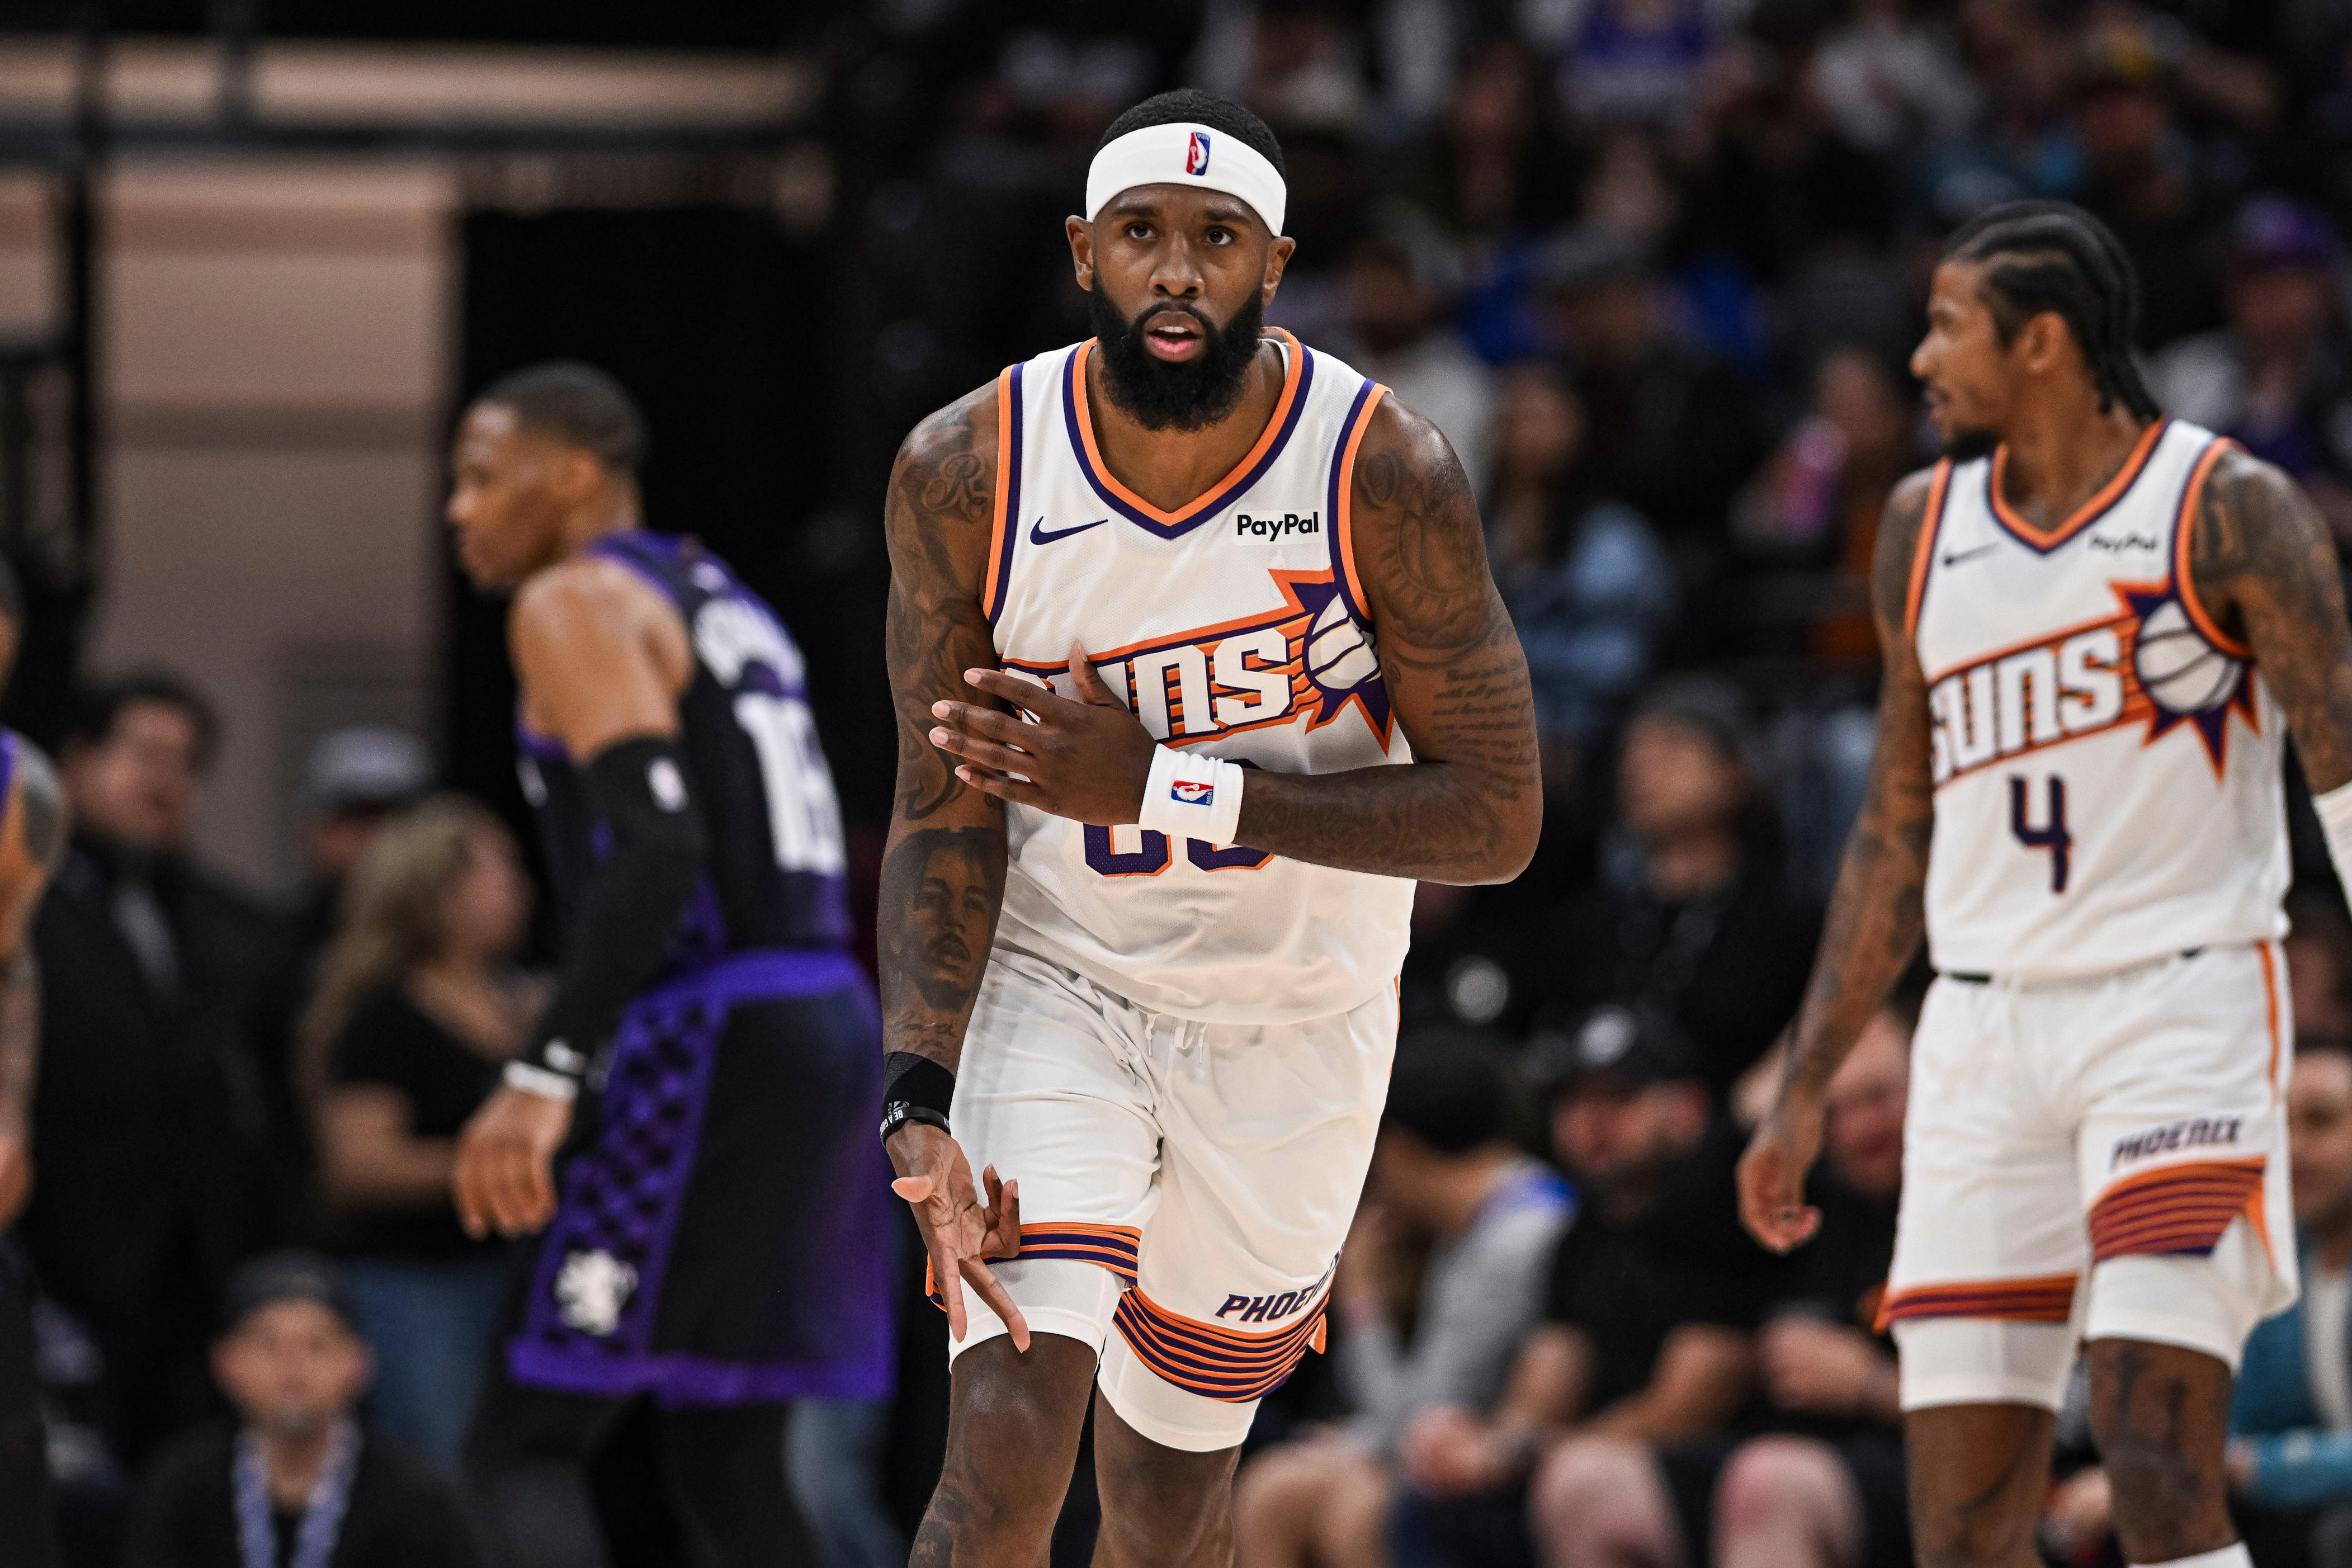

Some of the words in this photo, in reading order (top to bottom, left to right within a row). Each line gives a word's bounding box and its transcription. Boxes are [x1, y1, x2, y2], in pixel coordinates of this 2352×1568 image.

[1237, 511, 1319, 542] PayPal
[2010, 774, 2071, 895] 4
[888, 1114, 893, 1124] A
[894, 1109, 904, 1121] BE
